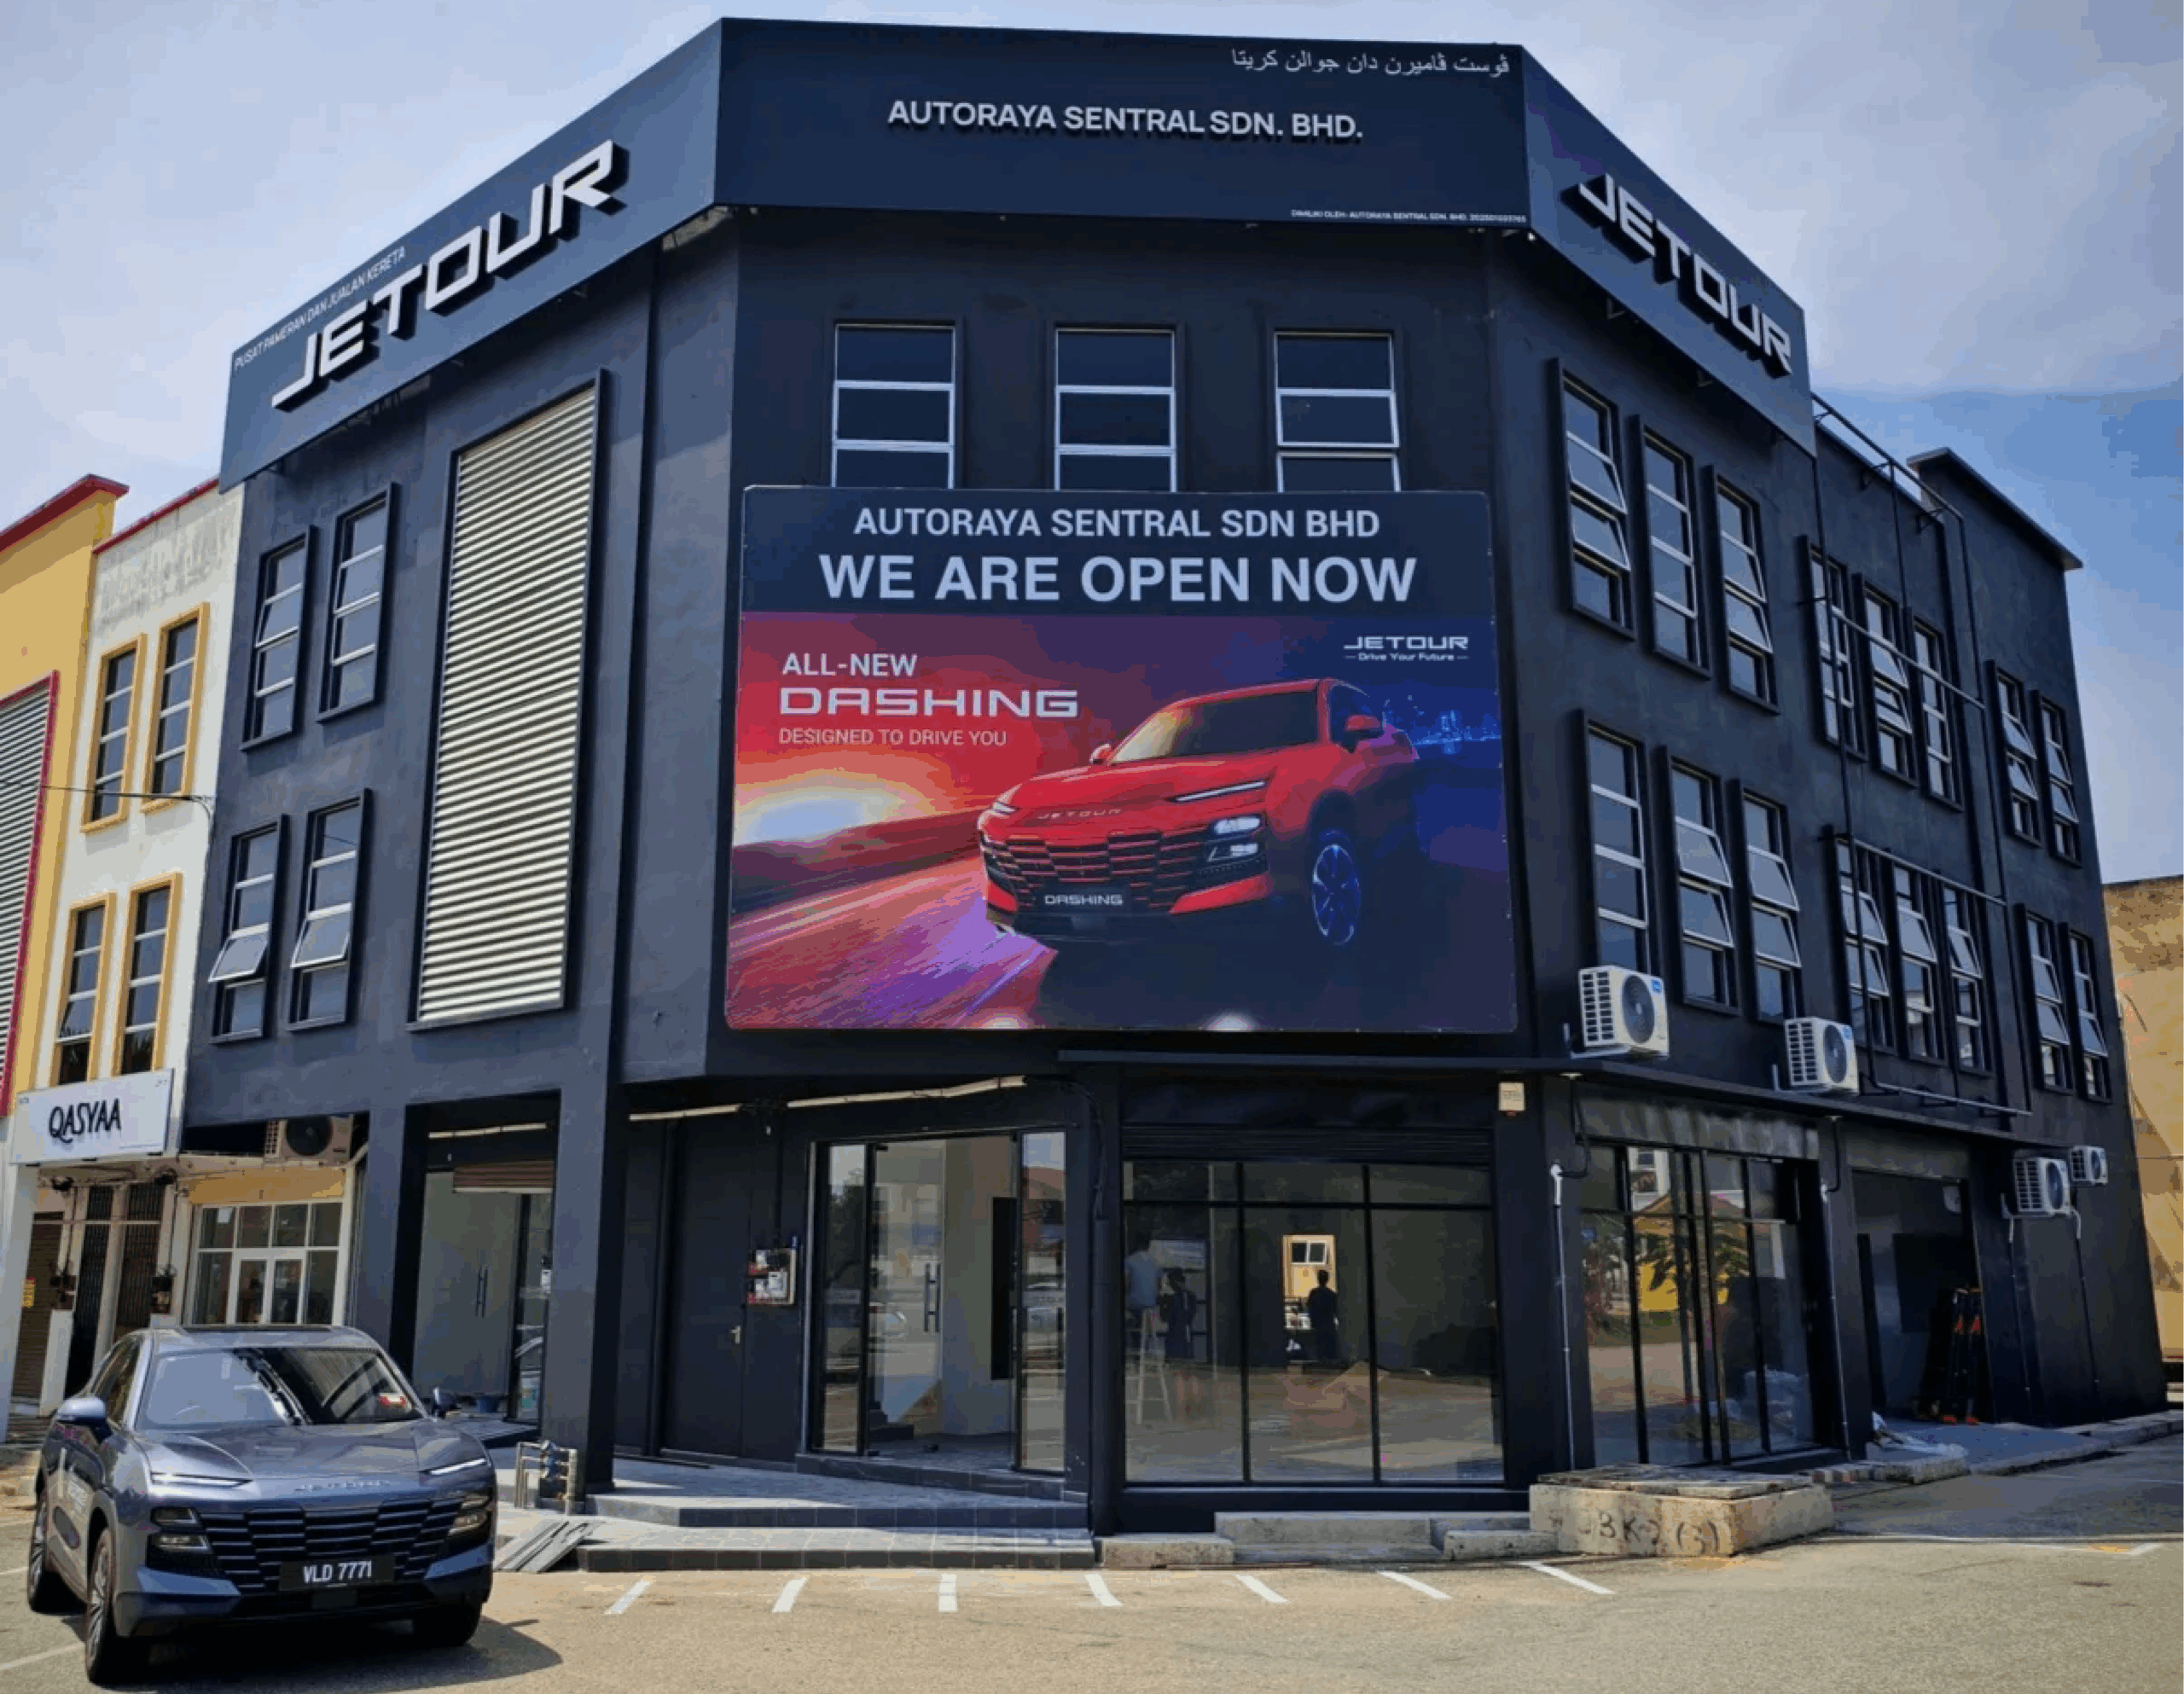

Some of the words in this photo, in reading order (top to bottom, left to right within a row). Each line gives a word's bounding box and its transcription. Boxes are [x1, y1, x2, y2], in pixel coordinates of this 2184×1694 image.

[887, 101, 1057, 129] AUTORAYA
[1063, 107, 1205, 133] SENTRAL
[1209, 111, 1284, 136] SDN.
[1291, 113, 1363, 138] BHD.
[271, 138, 613, 409] JETOUR
[1578, 172, 1792, 375] JETOUR
[233, 339, 266, 371] PUSAT
[264, 312, 306, 351] PAMERAN
[307, 299, 328, 324] DAN
[328, 275, 366, 309] JUALAN
[367, 245, 406, 282] KERETA
[853, 508, 1043, 537] AUTORAYA
[1051, 509, 1211, 537] SENTRAL
[1221, 510, 1295, 538] SDN
[1306, 510, 1380, 538] BHD
[818, 554, 915, 600] WE
[934, 556, 1060, 600] ARE
[1081, 556, 1250, 602] OPEN
[1271, 556, 1418, 602] NOW
[1343, 635, 1469, 650] JETOUR
[781, 652, 918, 676] ALL-NEW
[780, 687, 1078, 718] DASHING
[778, 728, 874, 745] DESIGNED
[880, 728, 904, 745] TO
[909, 729, 965, 745] DRIVE
[968, 730, 1008, 746] YOU
[1045, 894, 1124, 906] DASHING
[49, 1098, 122, 1144] QASYAA
[303, 1563, 333, 1583] VLD
[337, 1559, 372, 1581] 7771
